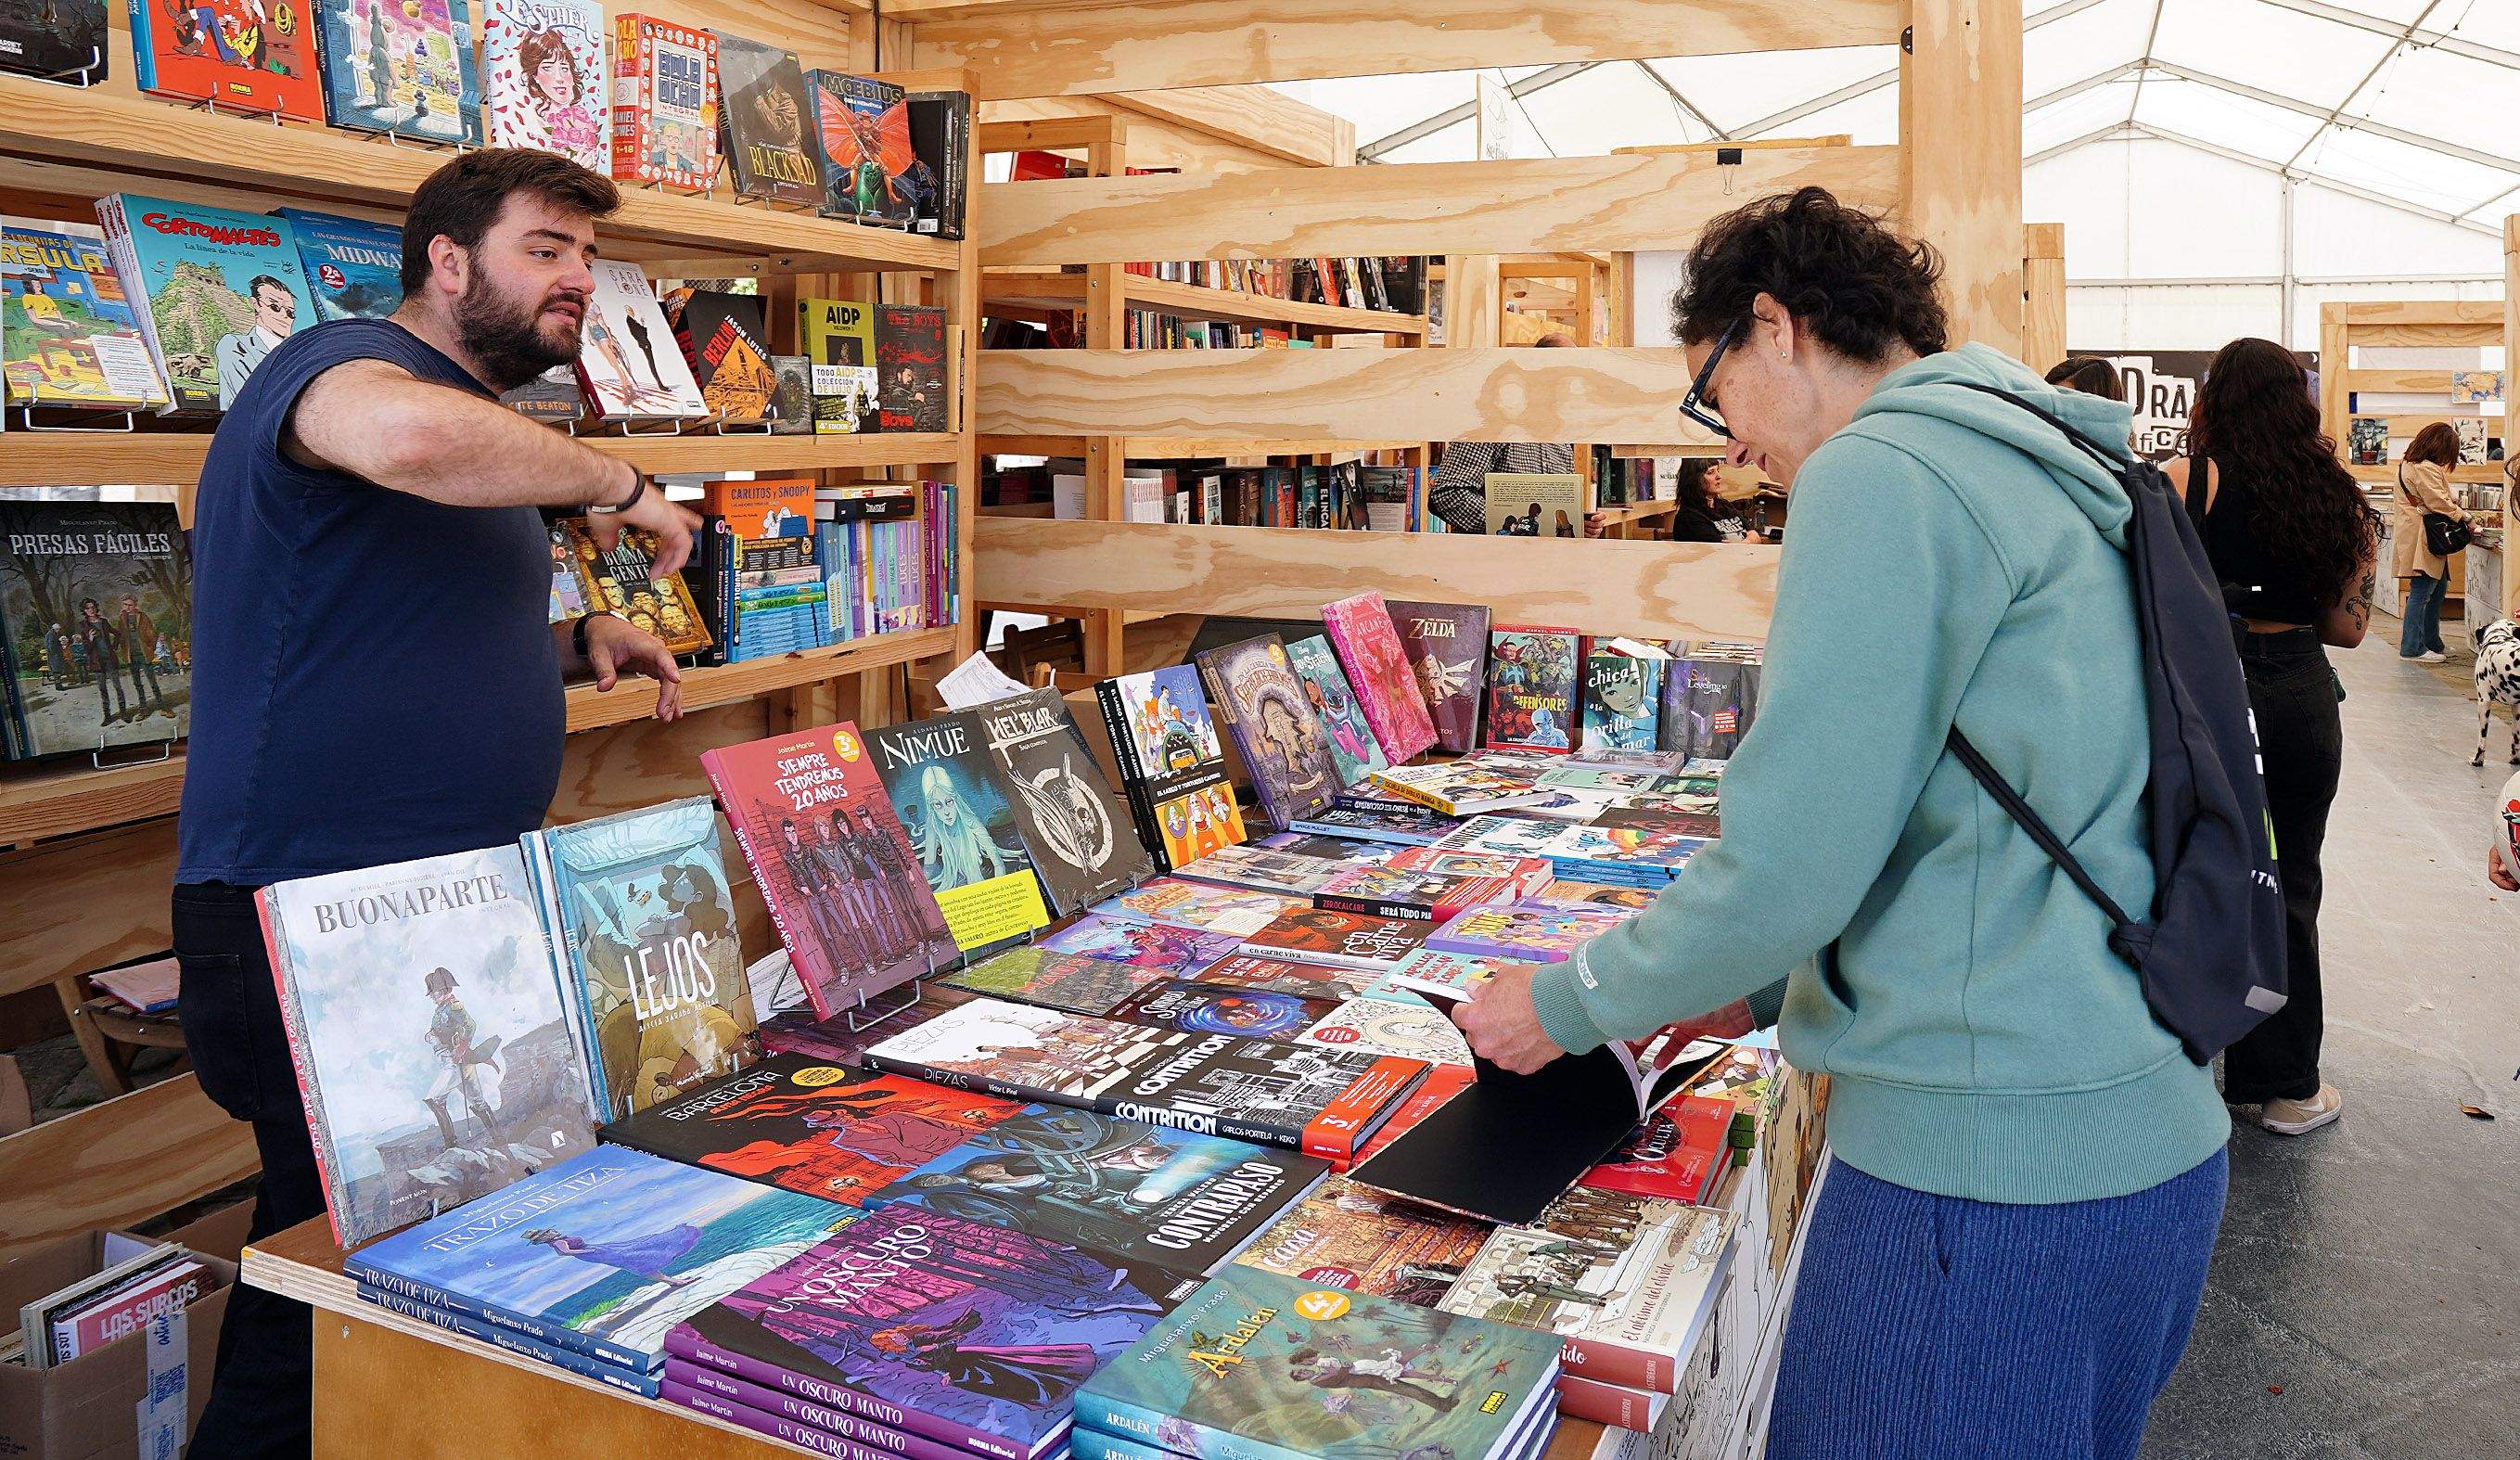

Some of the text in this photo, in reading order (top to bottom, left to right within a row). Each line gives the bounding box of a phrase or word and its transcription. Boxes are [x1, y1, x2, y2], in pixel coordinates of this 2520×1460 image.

[659, 50, 700, 84] BOLA
[659, 77, 700, 110] OCHO
[748, 147, 816, 186] BLACKSAD
[2, 243, 107, 275] RSULA
[826, 306, 861, 326] AIDP
[702, 322, 737, 367] BERLIN
[724, 314, 768, 361] JASON LUTES
[536, 401, 571, 412] BEATON
[731, 485, 810, 500] CARLITOS SNOOPY
[9, 530, 171, 556] PRESAS FÁCILES
[602, 547, 647, 567] BUENA
[899, 554, 908, 584] LUCES
[911, 552, 920, 583] LUCES
[734, 570, 742, 601] MURDLE
[1355, 616, 1384, 637] ARCANE
[1408, 619, 1456, 639] ZELDA
[1589, 668, 1630, 687] chica
[1514, 695, 1567, 711] DEFENSORES
[1101, 698, 1129, 781] LARGO TORTUOSO CAMINO
[1113, 697, 1141, 779] LARGO TORTUOSO CAMINO
[1592, 715, 1632, 738] orilla
[777, 753, 829, 777] SIEMPRE
[778, 744, 795, 755] Jaime
[880, 727, 970, 770] NIMUE
[710, 773, 732, 814] Jaime Martín
[774, 766, 844, 797] TENDREMOS
[791, 784, 848, 813] 20 AÑOS
[1164, 786, 1177, 796] LARGO
[1385, 780, 1436, 805] ESCUELA DIBUJO MANGA
[313, 874, 508, 934] BUONAPARTE
[733, 826, 797, 954] SIEMPRE TENDREMOS 20 AÑOS
[478, 903, 511, 914] INTEGRAL
[1322, 898, 1420, 920] ZEROCALCARE SERÁ TODO
[1260, 949, 1283, 958] carne
[1284, 952, 1301, 960] viva
[624, 931, 716, 1021] LEJOS
[281, 993, 296, 1035] OBSCENA
[924, 1068, 968, 1089] PIEZAS
[1133, 1034, 1236, 1095] CONTRITION
[667, 1070, 785, 1122] BARCELONA
[1116, 1101, 1297, 1146] CONTRITION CARLOS PORTELA KEKO
[423, 1165, 624, 1253] TRAZO DE TIZA
[462, 1182, 542, 1218] Miguelanxo Prado
[1146, 1161, 1284, 1249] CONTRAPASO
[1239, 1200, 1257, 1215] CON
[1262, 1229, 1318, 1268] casa
[768, 1224, 927, 1314] UN OSCURO
[824, 1245, 932, 1310] MANTO
[364, 1268, 404, 1294] TRAZO
[404, 1283, 421, 1300] DE
[421, 1288, 450, 1310] TIZA
[482, 1309, 522, 1329] Miguelanxo
[523, 1320, 544, 1336] Prado
[1621, 1262, 1675, 1341] El abismo del olvido
[375, 1291, 416, 1317] TRAZO
[416, 1305, 432, 1323] DE
[432, 1312, 461, 1334] TIZA
[492, 1334, 532, 1355] Miguelanxo
[532, 1346, 553, 1362] Prado
[1137, 1287, 1231, 1365] Miguelanxo Prado
[1186, 1306, 1281, 1380] Ardalén
[1561, 1344, 1587, 1365] ido
[696, 1349, 714, 1363] Jaime
[715, 1353, 738, 1369] Martín
[781, 1374, 796, 1390] UN
[799, 1378, 851, 1411] OSCURO
[856, 1398, 903, 1425] MANTO
[691, 1397, 710, 1409] Jaime
[710, 1402, 733, 1417] Martín
[778, 1423, 793, 1439] UN
[795, 1428, 850, 1460] OSCURO
[697, 1374, 906, 1453] Jaime Martín UN OSCURO MANTO
[1105, 1411, 1151, 1435] ARDALÉN
